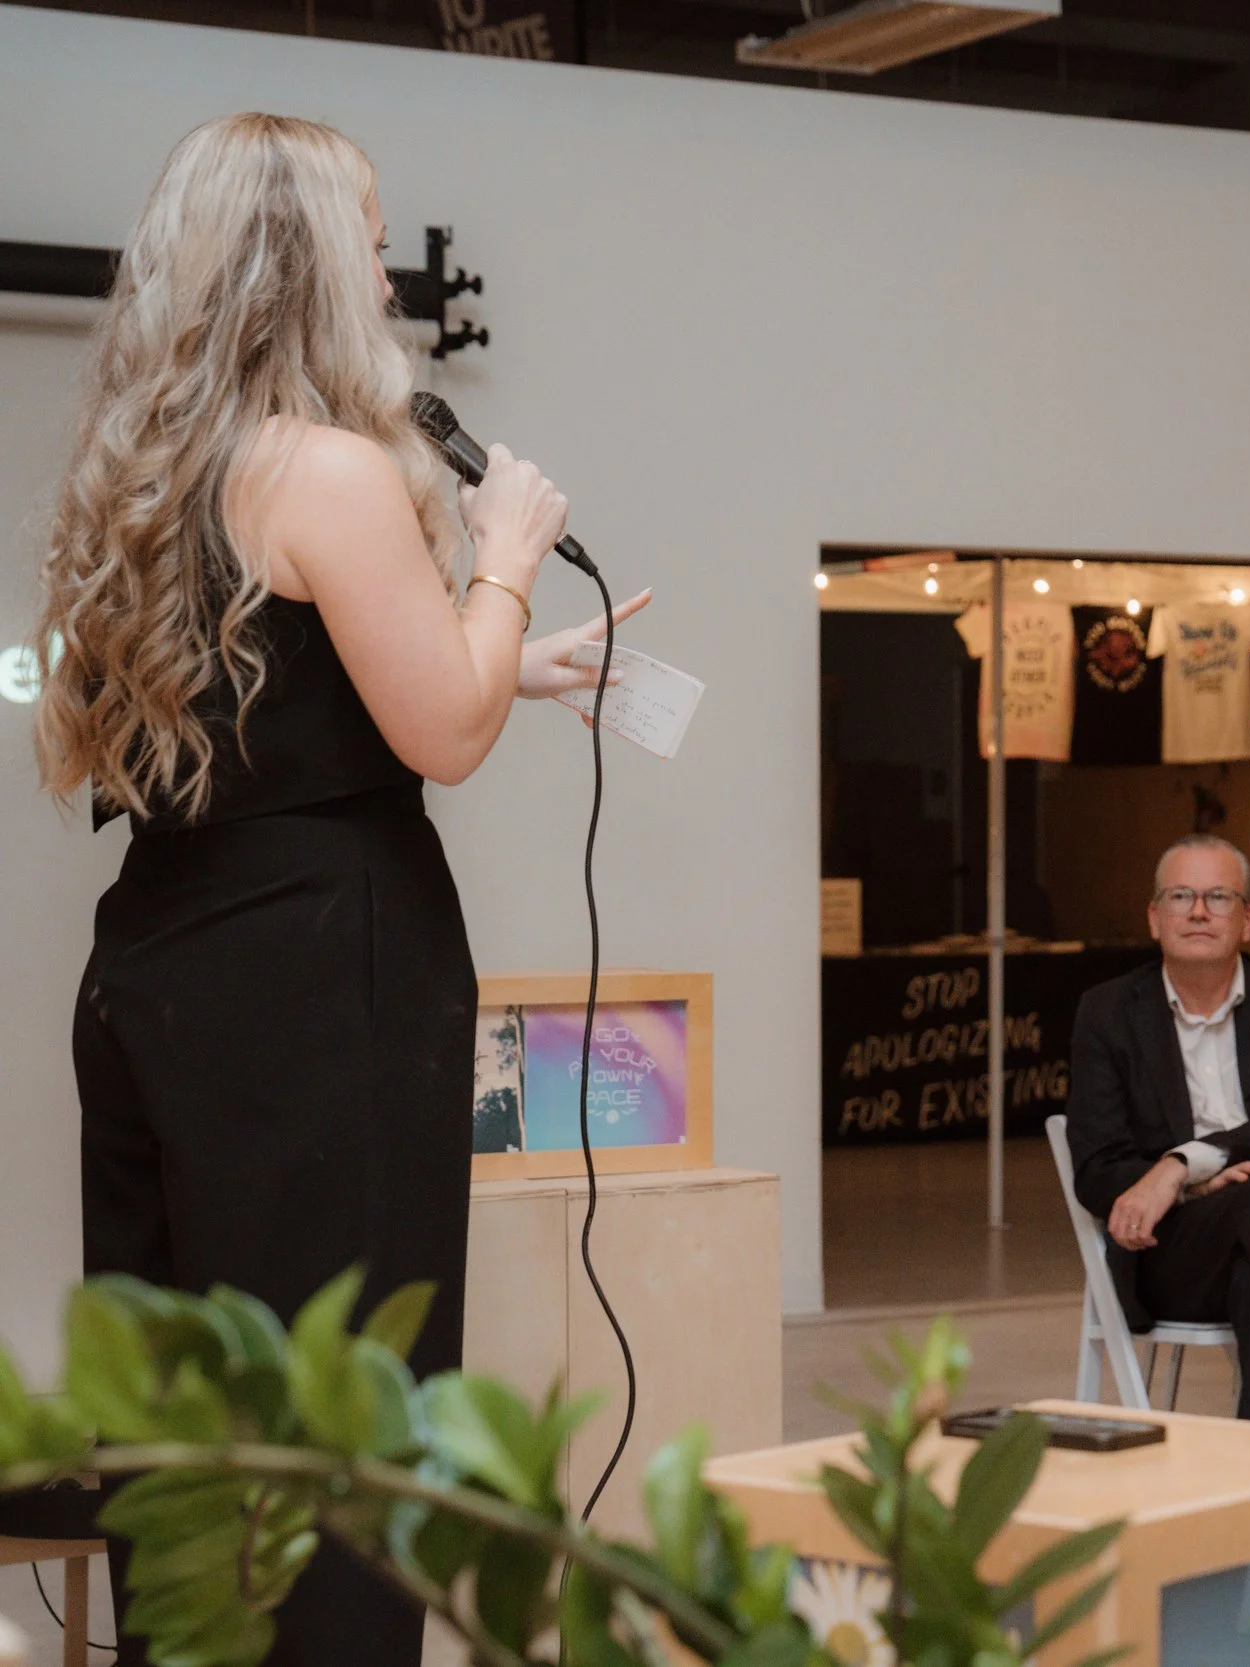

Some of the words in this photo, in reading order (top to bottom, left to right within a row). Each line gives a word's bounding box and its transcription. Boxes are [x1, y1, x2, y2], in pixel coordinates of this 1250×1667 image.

[902, 967, 980, 1020] STOP
[594, 1027, 630, 1043] GO
[841, 1012, 1041, 1079] APOLOGIZNG
[593, 1069, 634, 1084] OWN
[600, 1048, 657, 1075] YOUR
[838, 1090, 904, 1135] FOR
